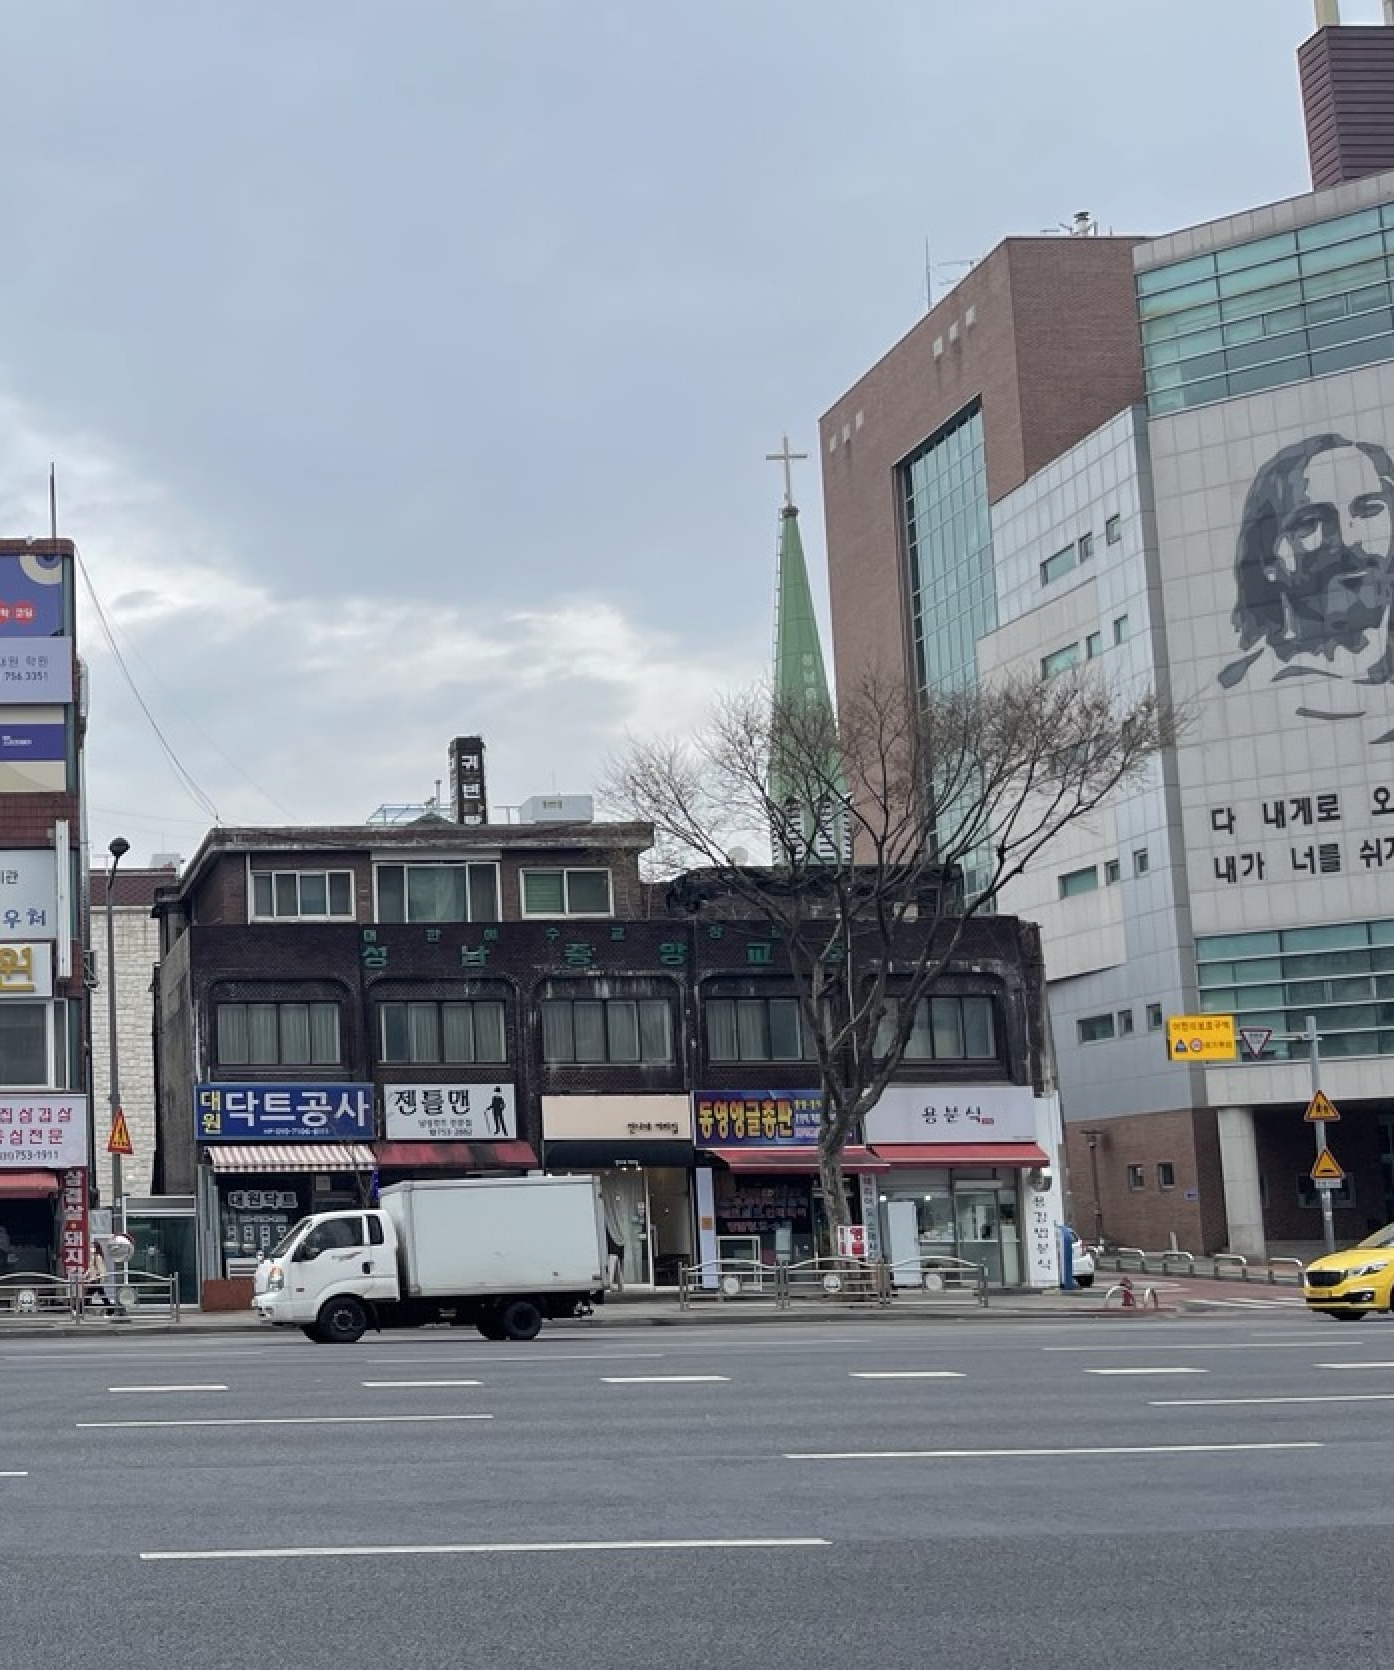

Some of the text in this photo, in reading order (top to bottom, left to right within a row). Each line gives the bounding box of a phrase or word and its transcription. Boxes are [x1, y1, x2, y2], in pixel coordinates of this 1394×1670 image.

[1210, 807, 1237, 835] 다
[1261, 793, 1342, 829] 내게로
[1213, 851, 1265, 884] 내가
[1291, 842, 1341, 875] 너를
[199, 1090, 223, 1135] 대원
[225, 1090, 371, 1128] 닥트공사
[394, 1089, 471, 1117] 젠틀맨
